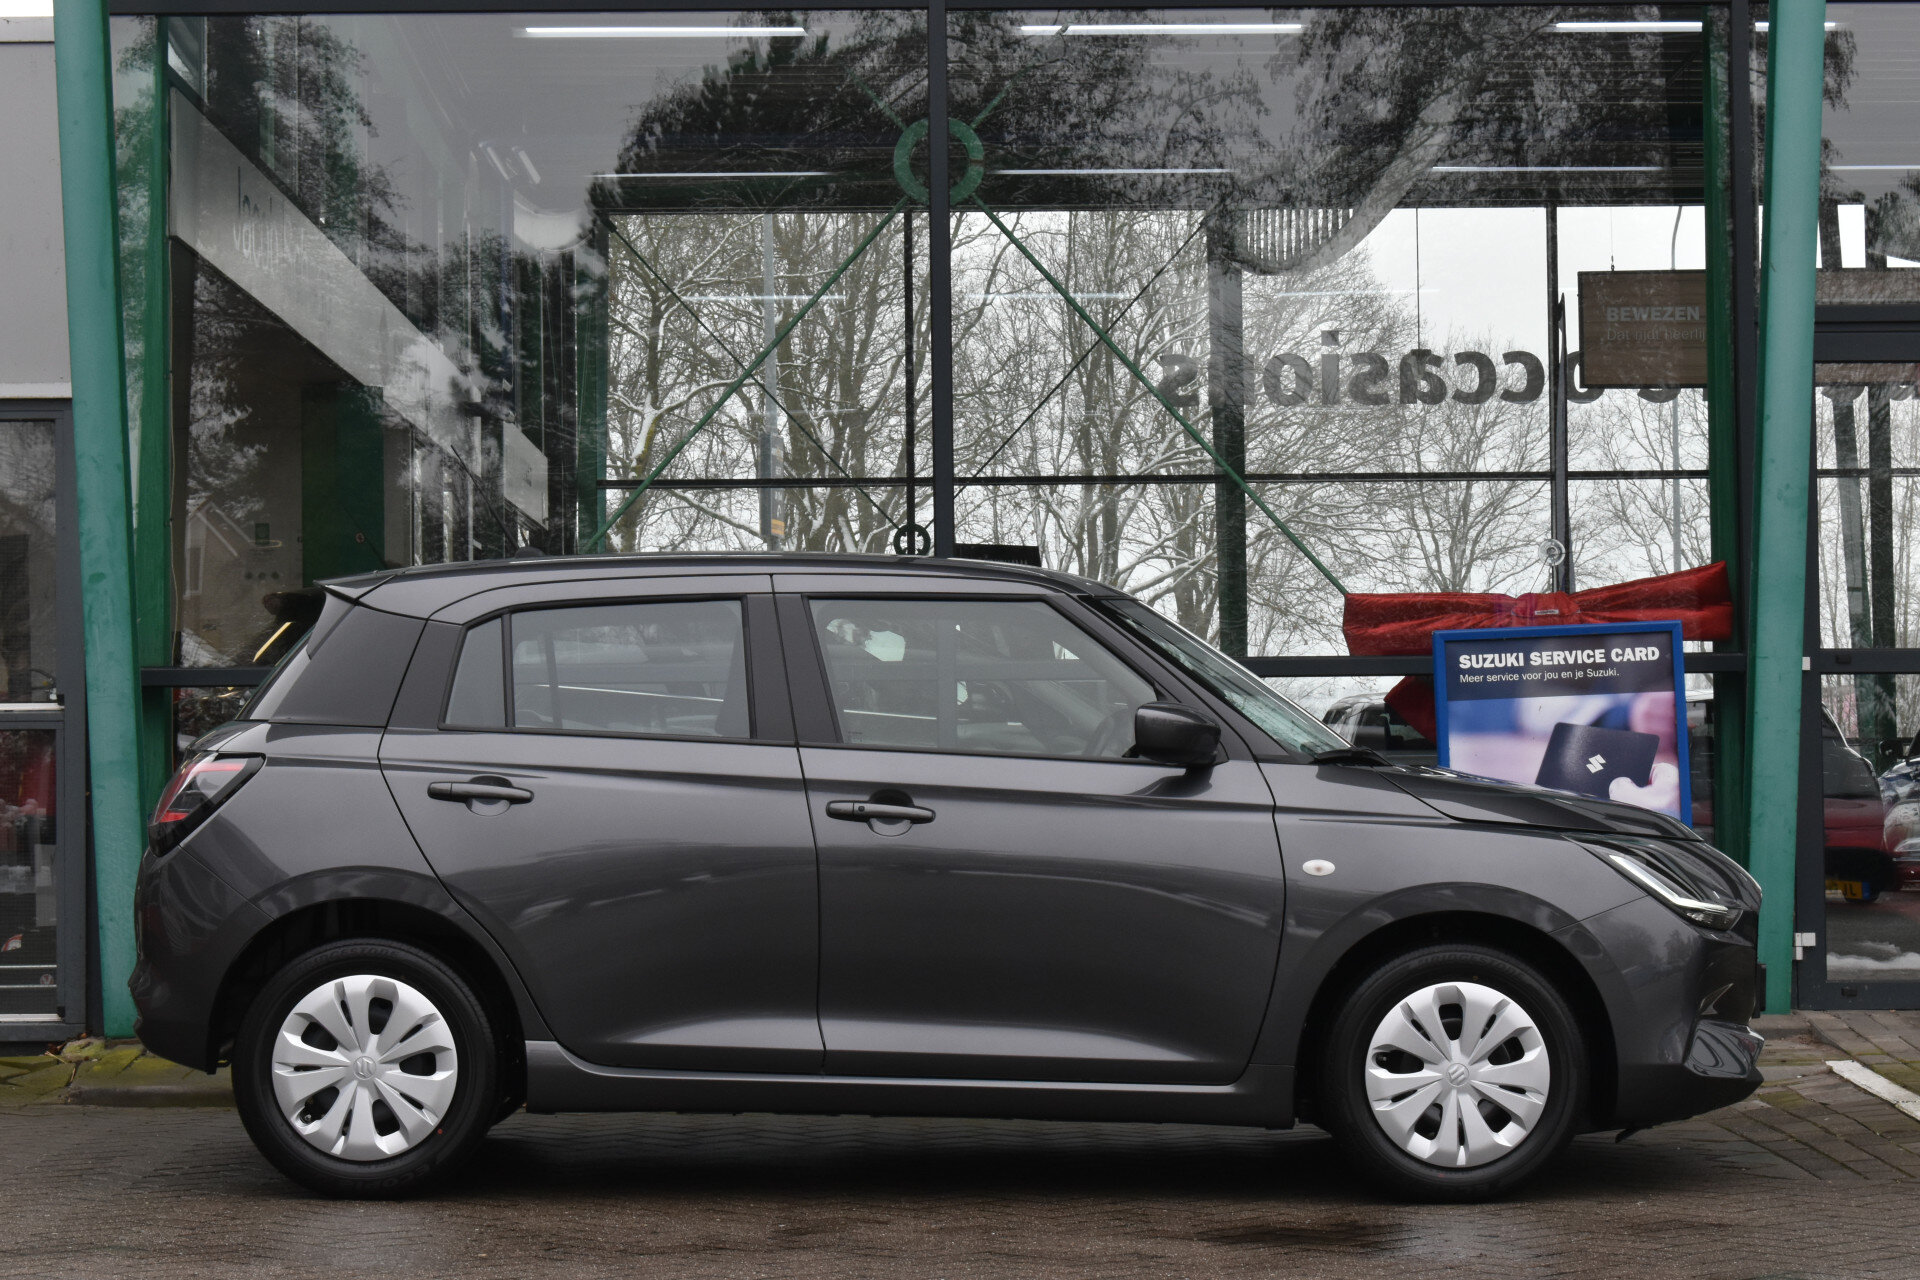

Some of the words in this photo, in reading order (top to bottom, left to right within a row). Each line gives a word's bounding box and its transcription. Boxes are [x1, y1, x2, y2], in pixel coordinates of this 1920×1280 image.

[1607, 306, 1700, 321] BEWEZEN
[1459, 652, 1525, 669] SUZUKI
[1529, 649, 1606, 666] SERVICE
[1610, 646, 1660, 662] CARD
[1459, 673, 1484, 683] Meer
[1486, 672, 1520, 682] service
[1521, 672, 1542, 681] voor
[1543, 670, 1559, 682] jou
[1561, 671, 1573, 679] en
[1575, 669, 1584, 680] je
[1586, 667, 1620, 678] Suzuki.
